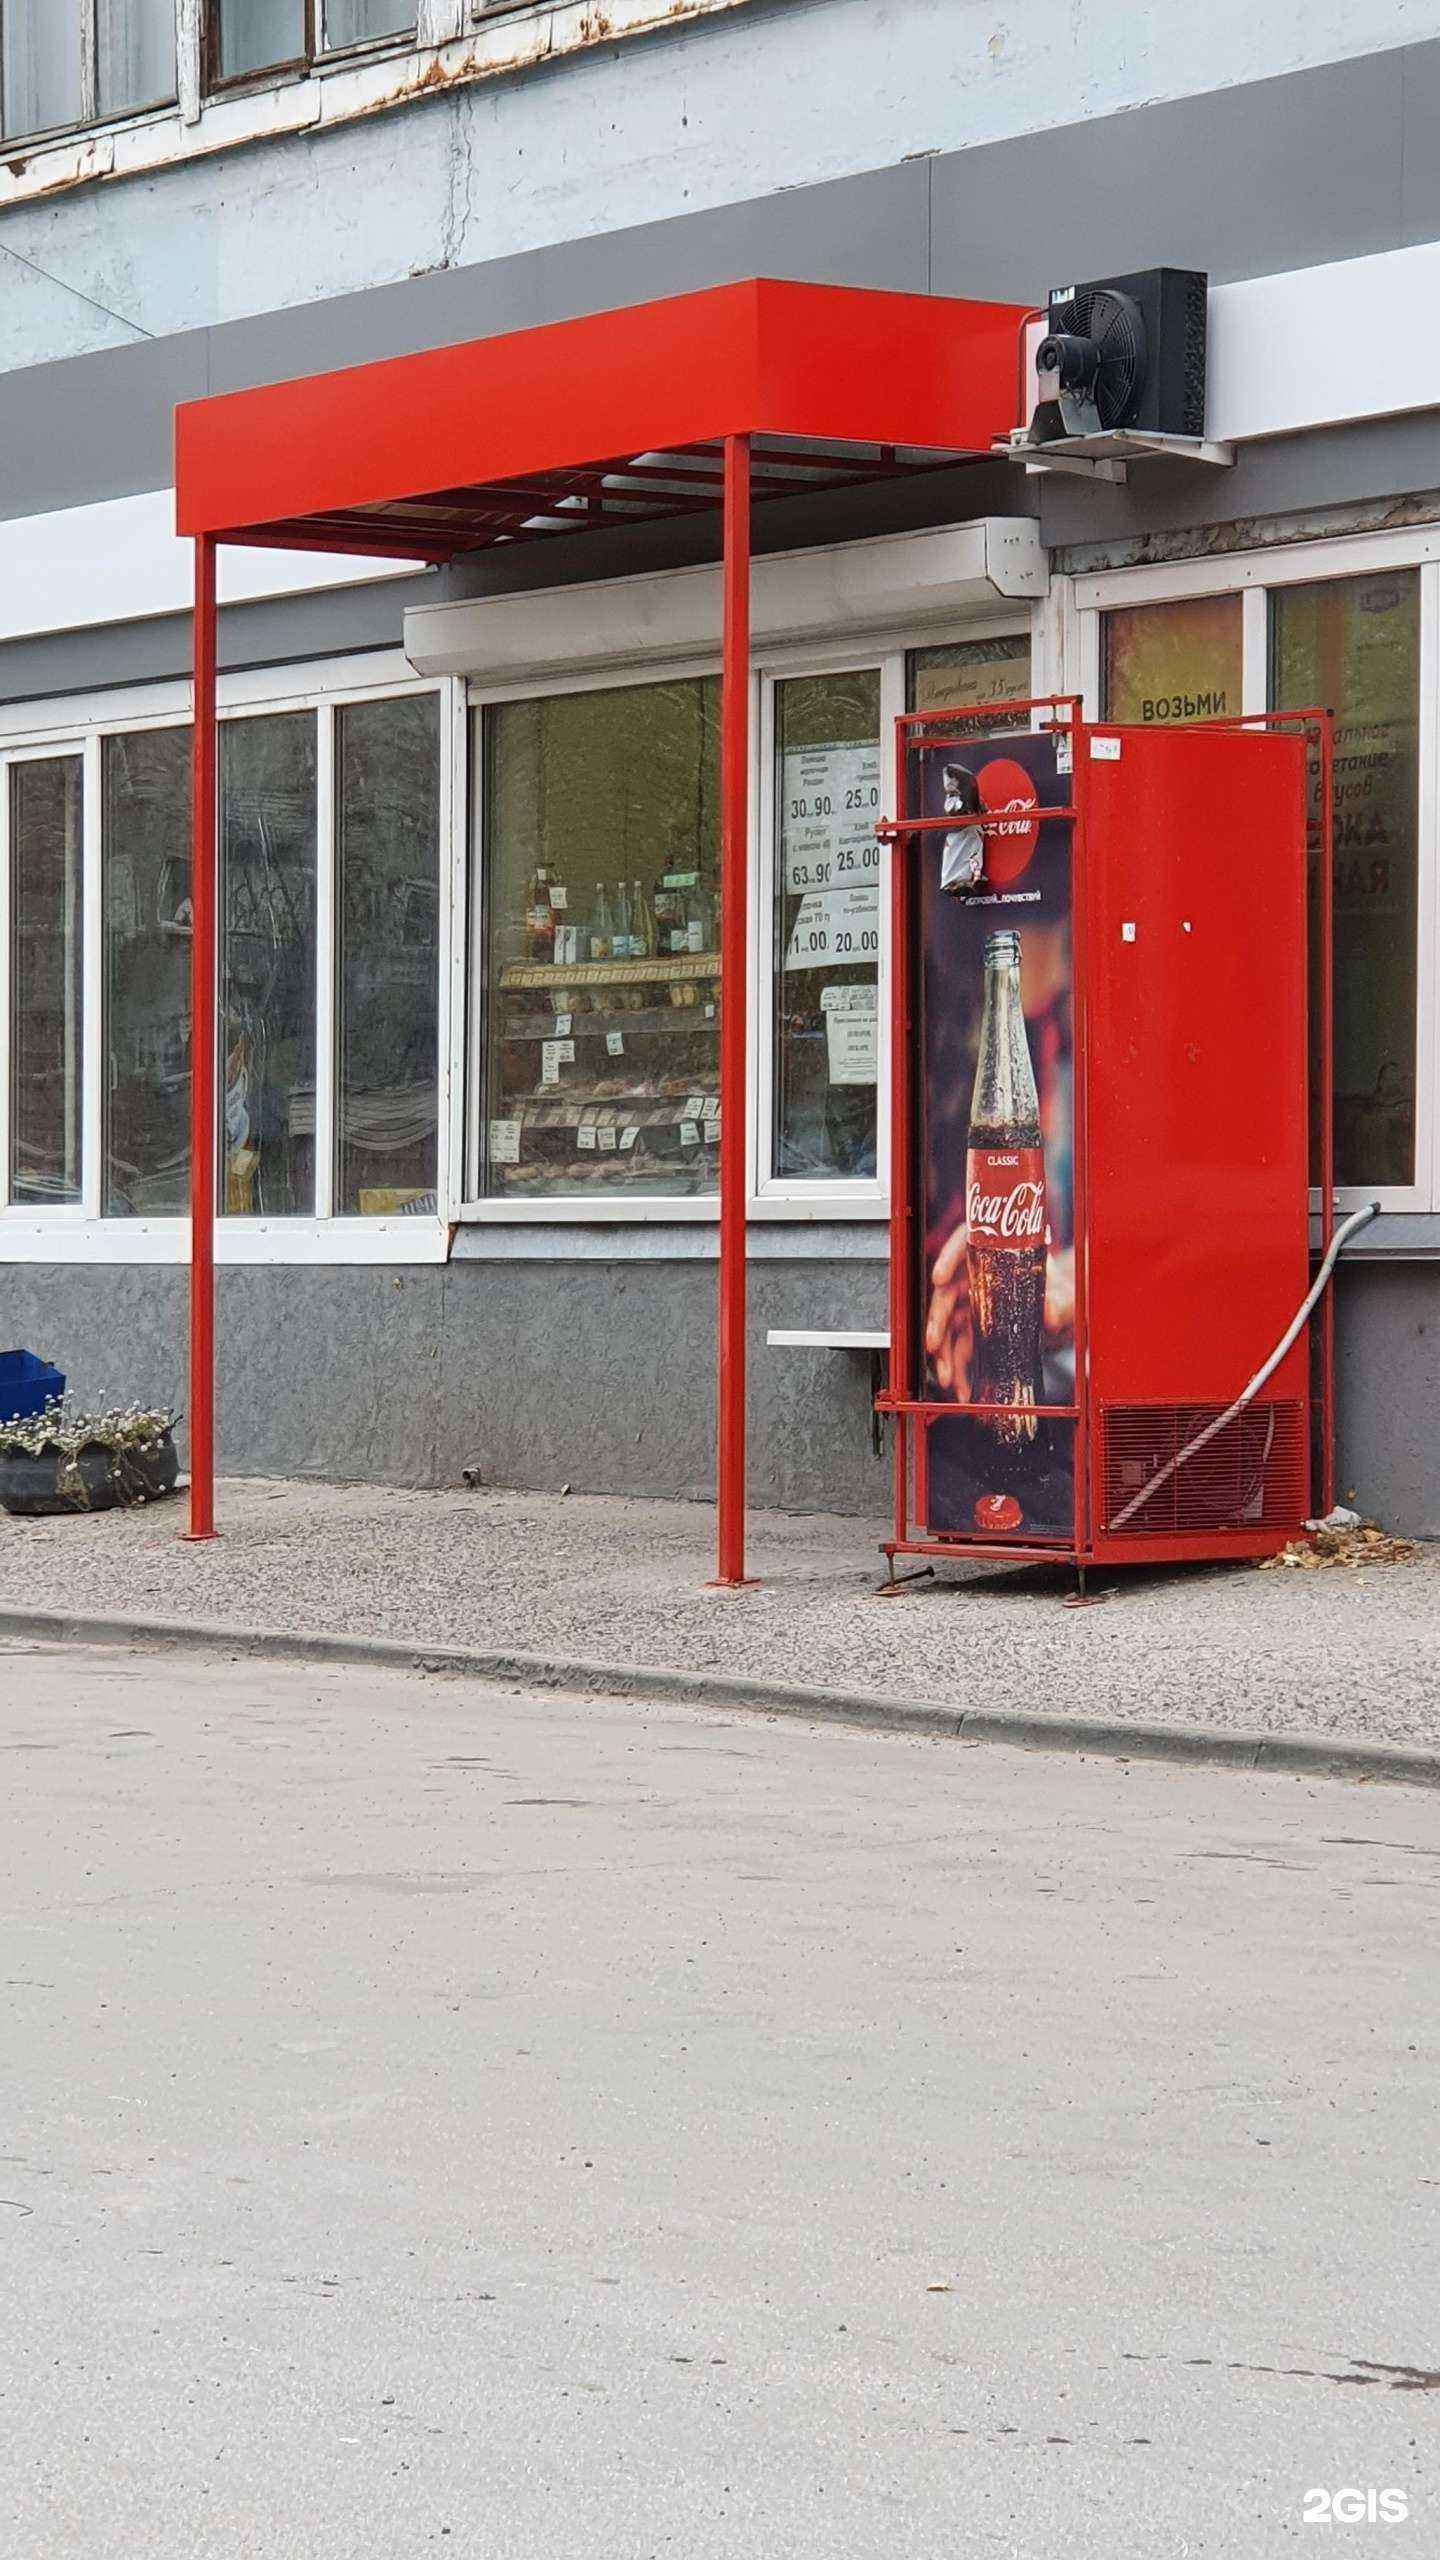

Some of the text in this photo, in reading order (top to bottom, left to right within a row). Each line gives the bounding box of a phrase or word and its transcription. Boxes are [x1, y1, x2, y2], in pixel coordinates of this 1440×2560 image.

[1142, 691, 1226, 721] ВОЗЬМИ
[1313, 774, 1374, 807] вусов
[987, 1155, 1019, 1167] CLASSIC
[967, 1181, 1045, 1237] Coca-Cola
